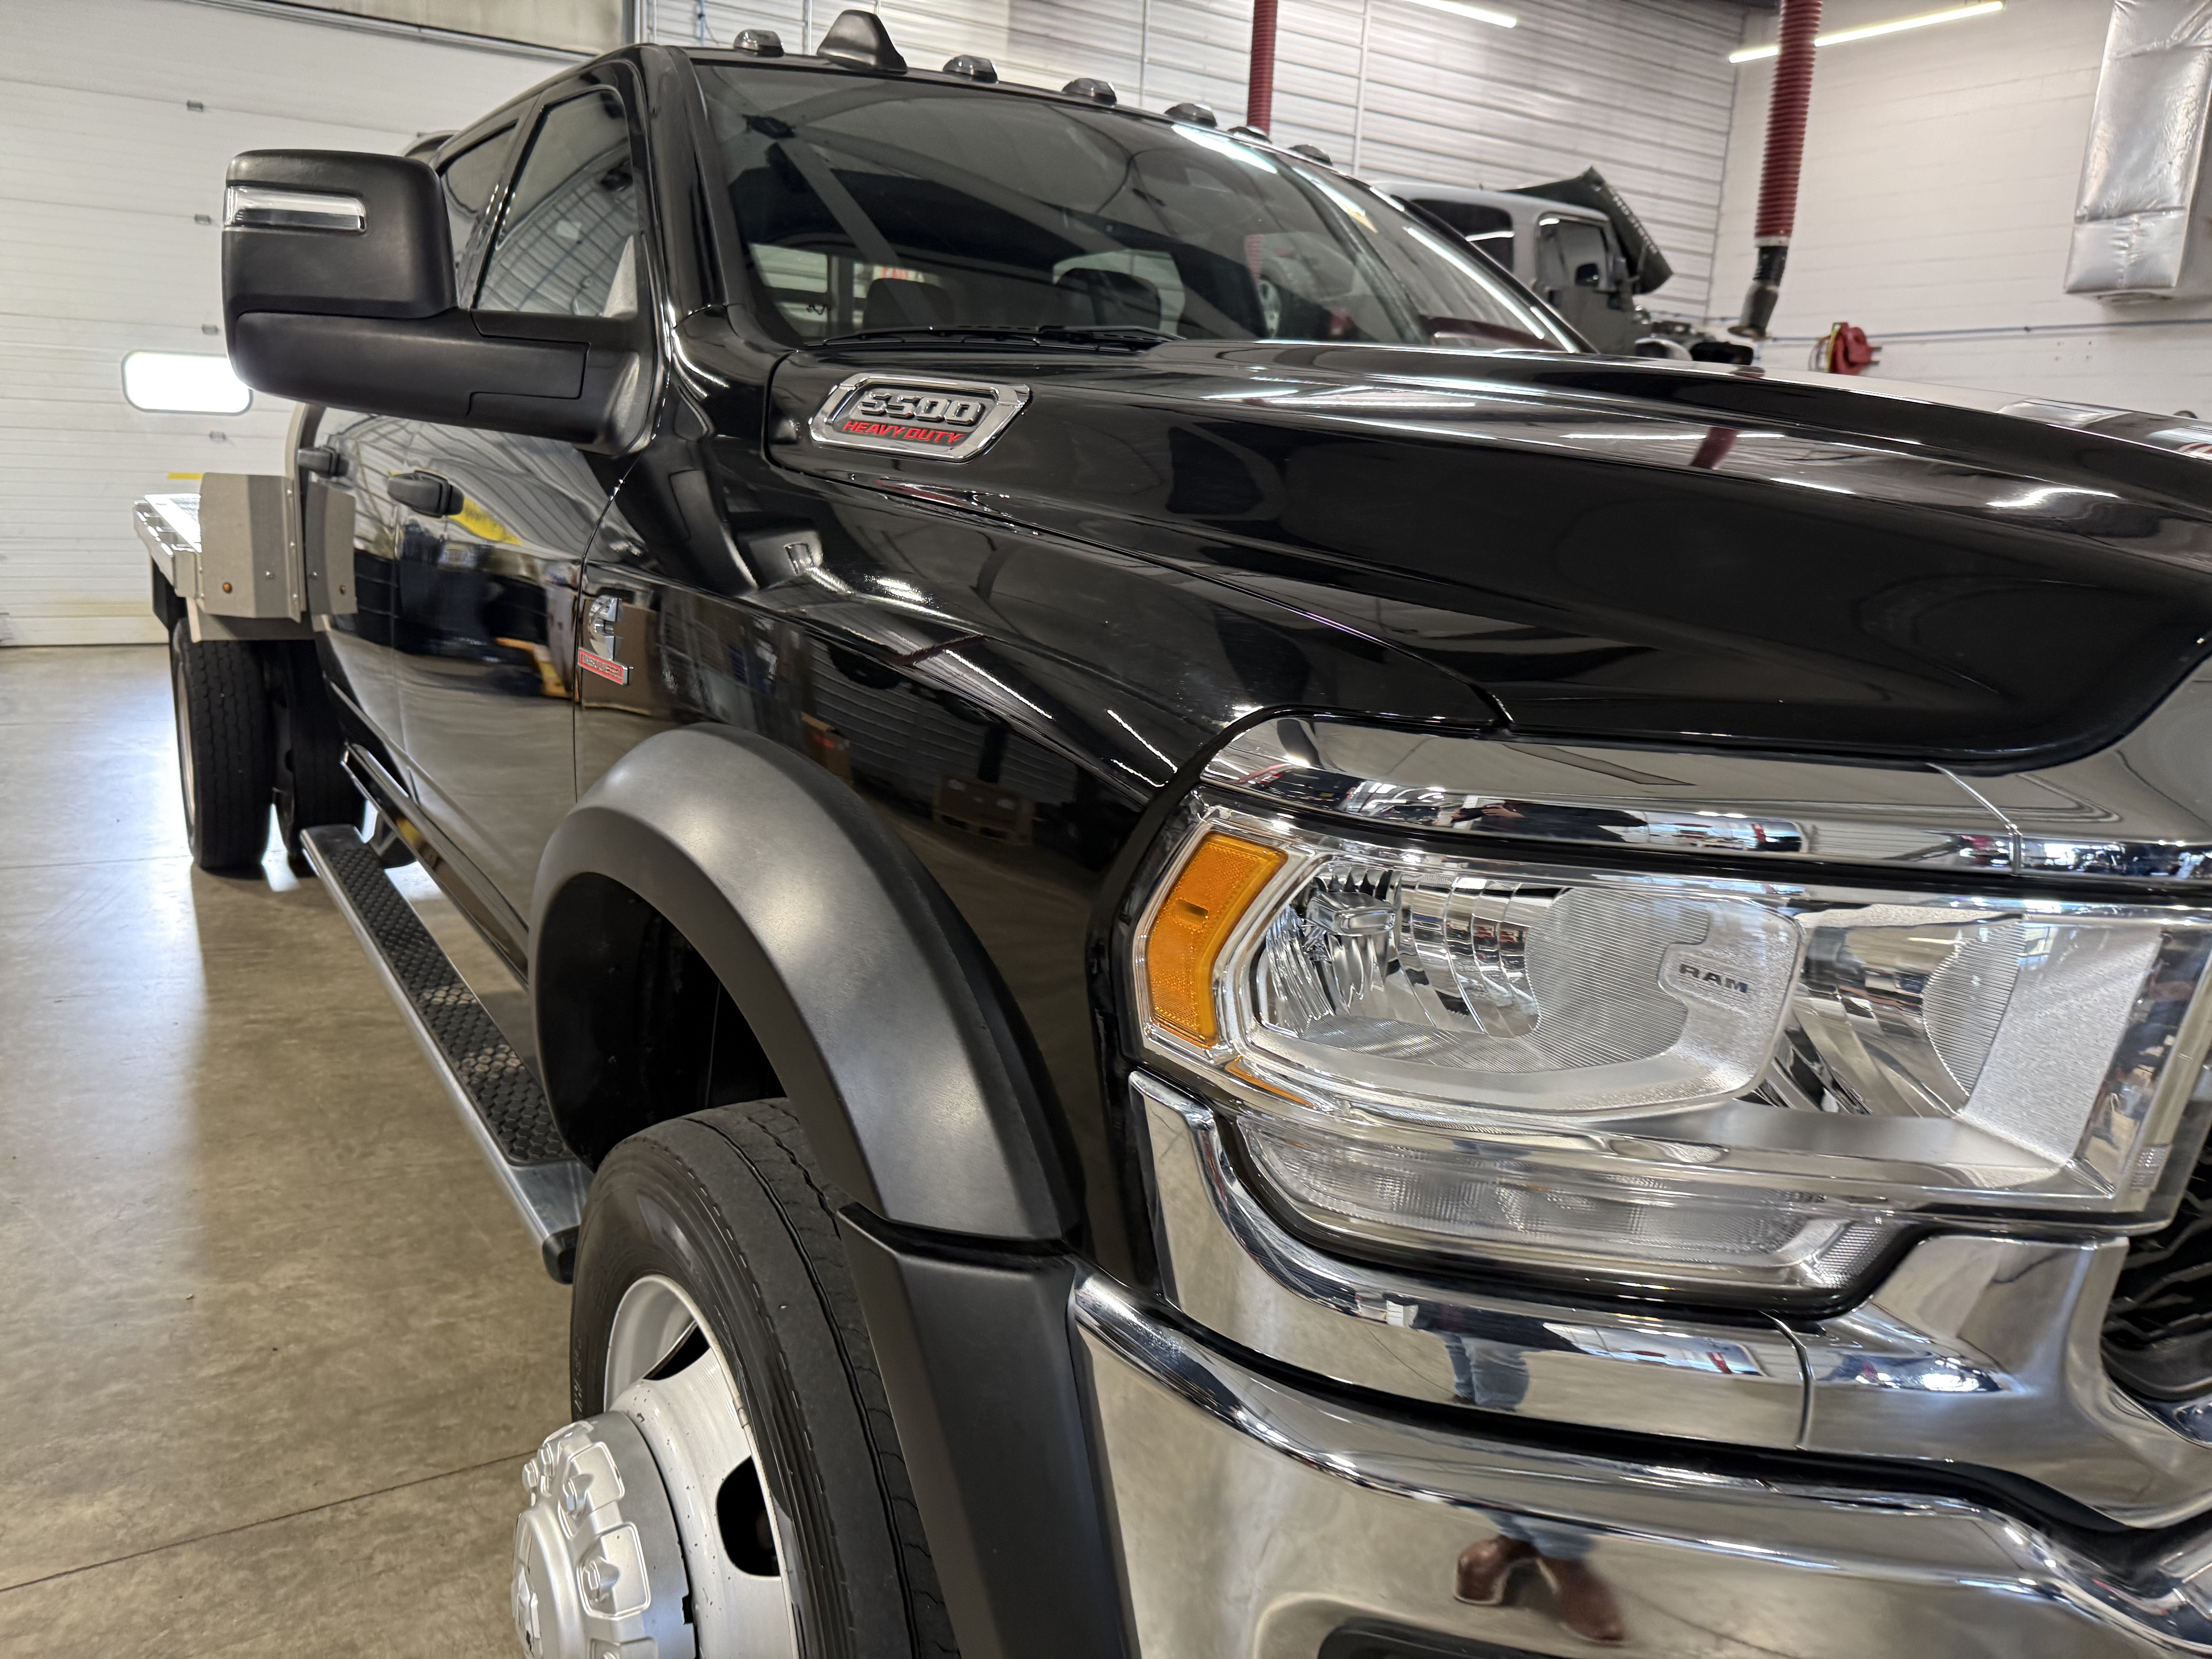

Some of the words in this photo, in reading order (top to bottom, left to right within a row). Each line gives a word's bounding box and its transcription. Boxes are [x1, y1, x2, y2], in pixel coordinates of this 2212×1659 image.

[857, 389, 984, 426] 5500
[842, 421, 906, 438] HEAVY
[904, 428, 963, 444] DUTY
[1678, 964, 1748, 993] RAM
